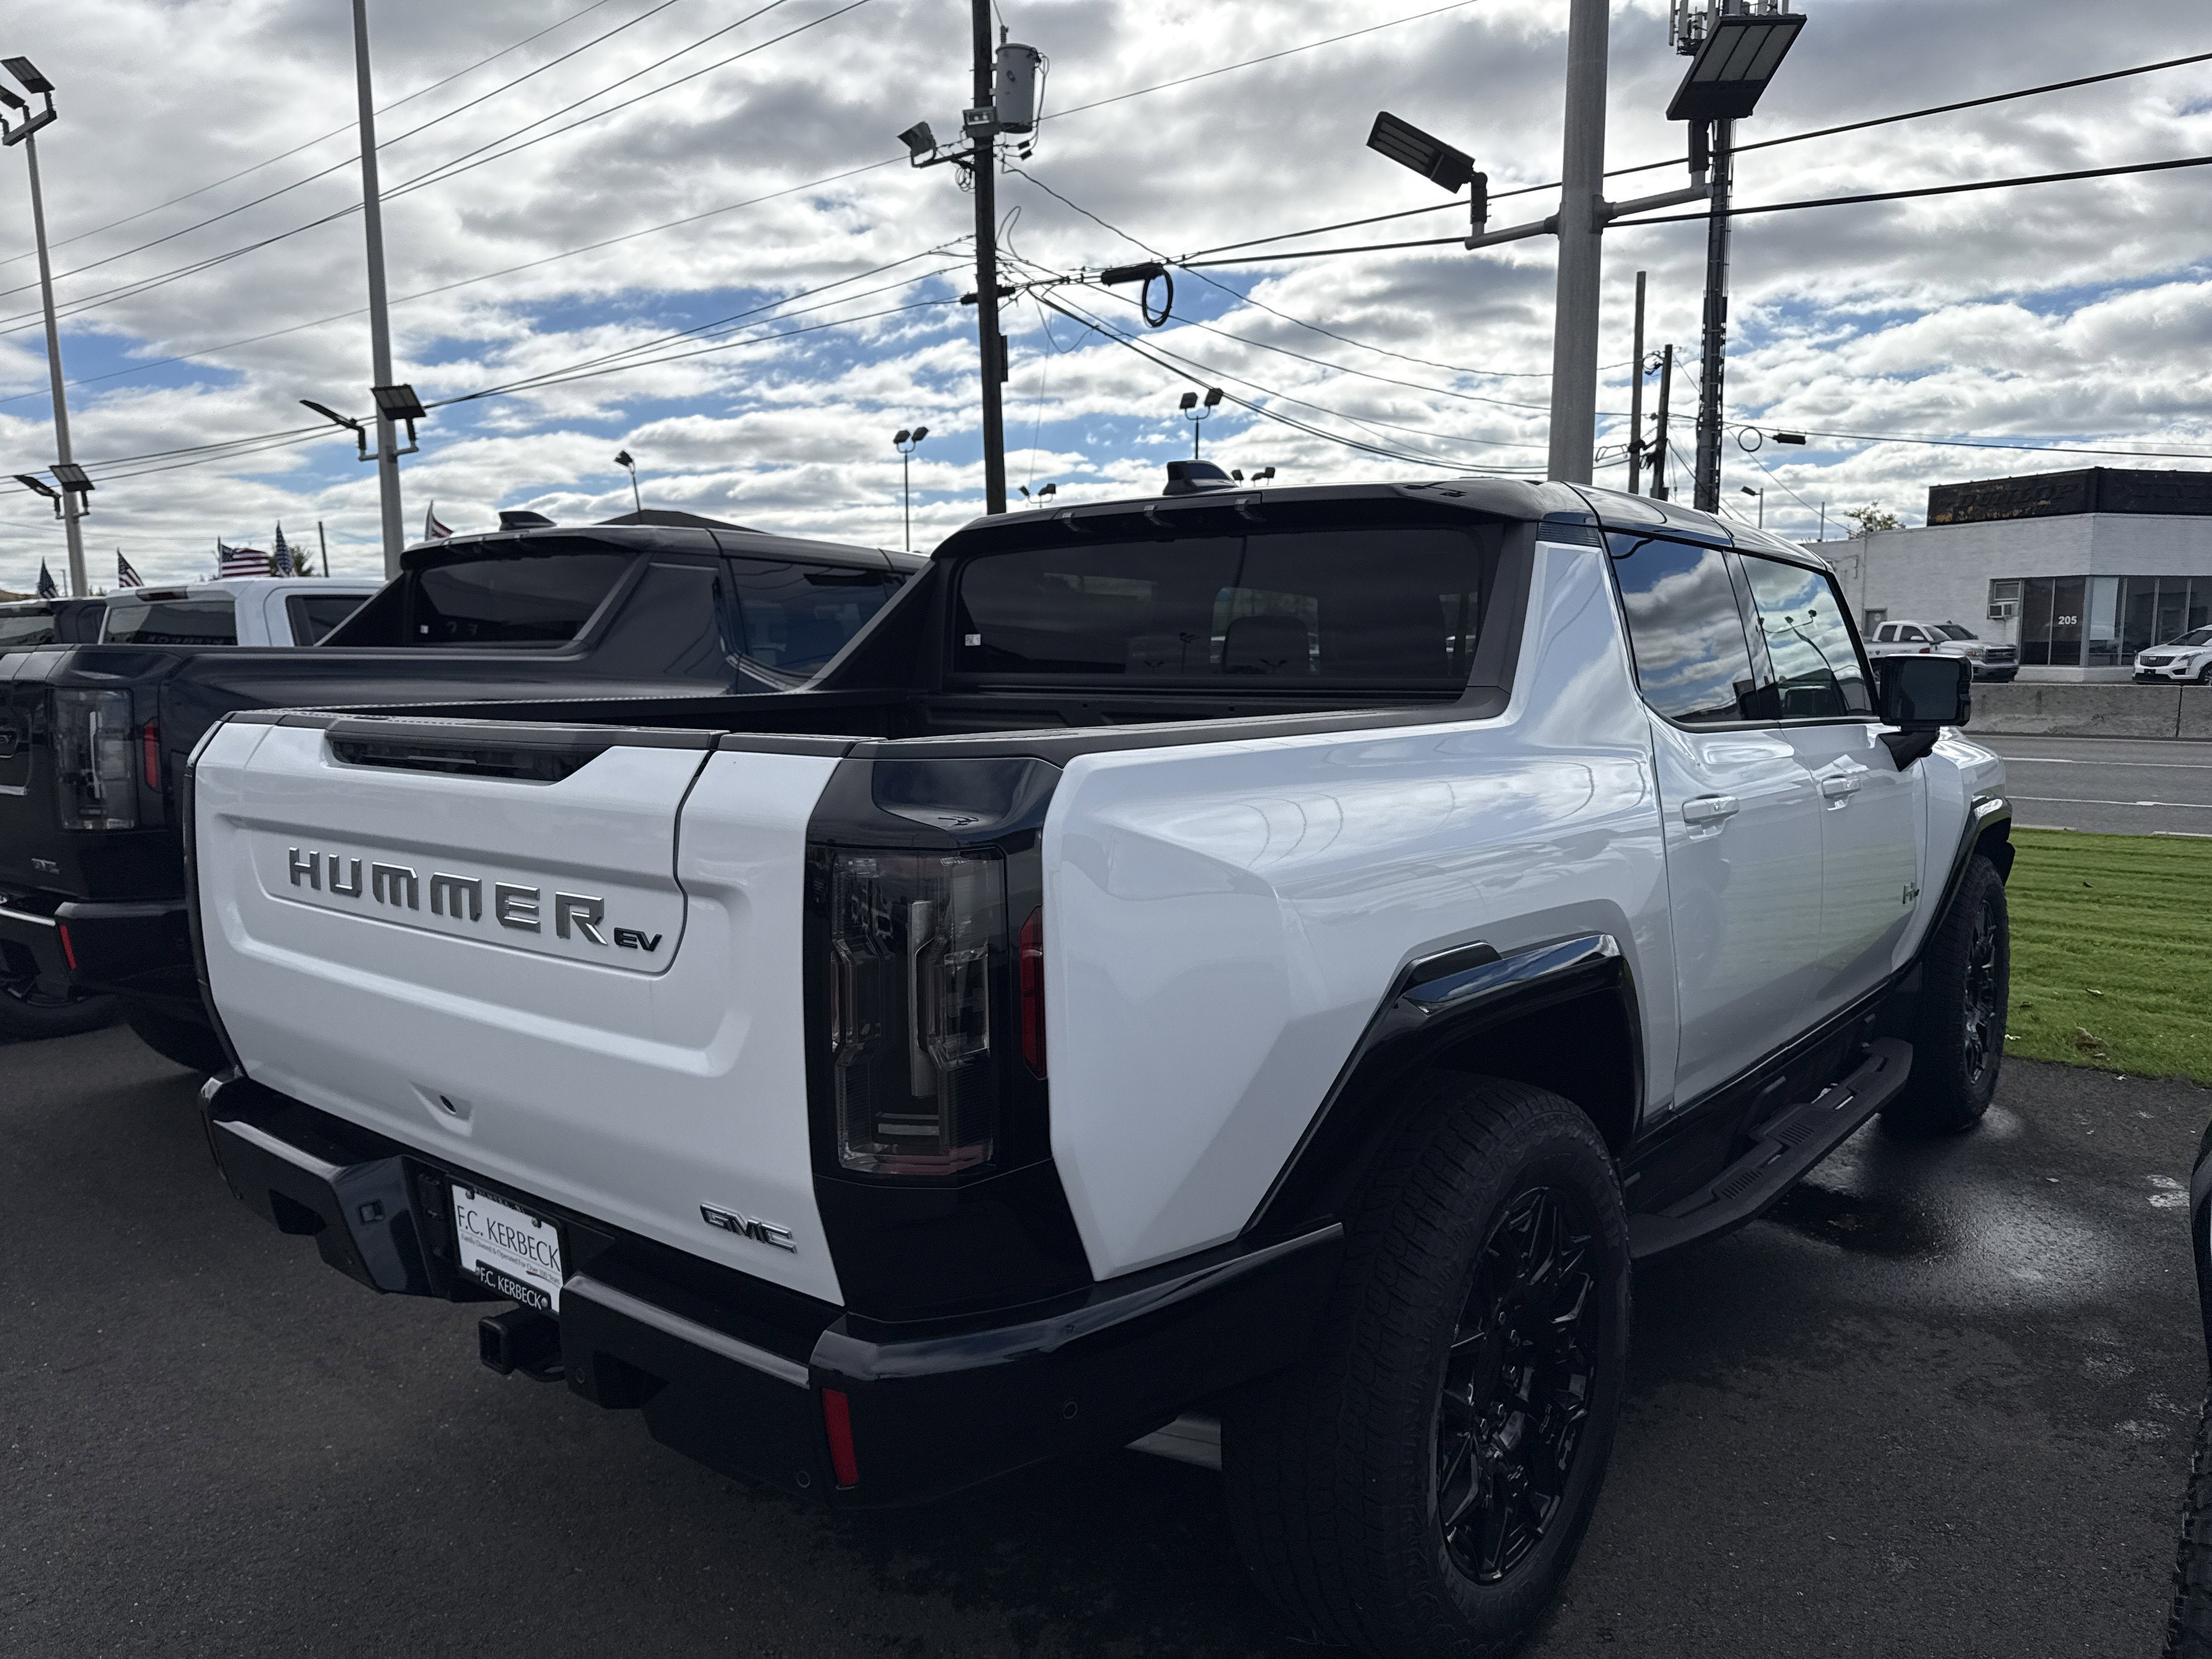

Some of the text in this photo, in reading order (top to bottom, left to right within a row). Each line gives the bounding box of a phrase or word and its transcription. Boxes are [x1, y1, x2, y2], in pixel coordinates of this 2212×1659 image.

[2058, 616, 2078, 625] 205
[289, 847, 663, 952] HUMMER EV
[457, 1205, 561, 1272] F.C. KERBECK
[699, 1203, 797, 1254] GMC
[480, 1267, 542, 1310] F.C. KERBECK
